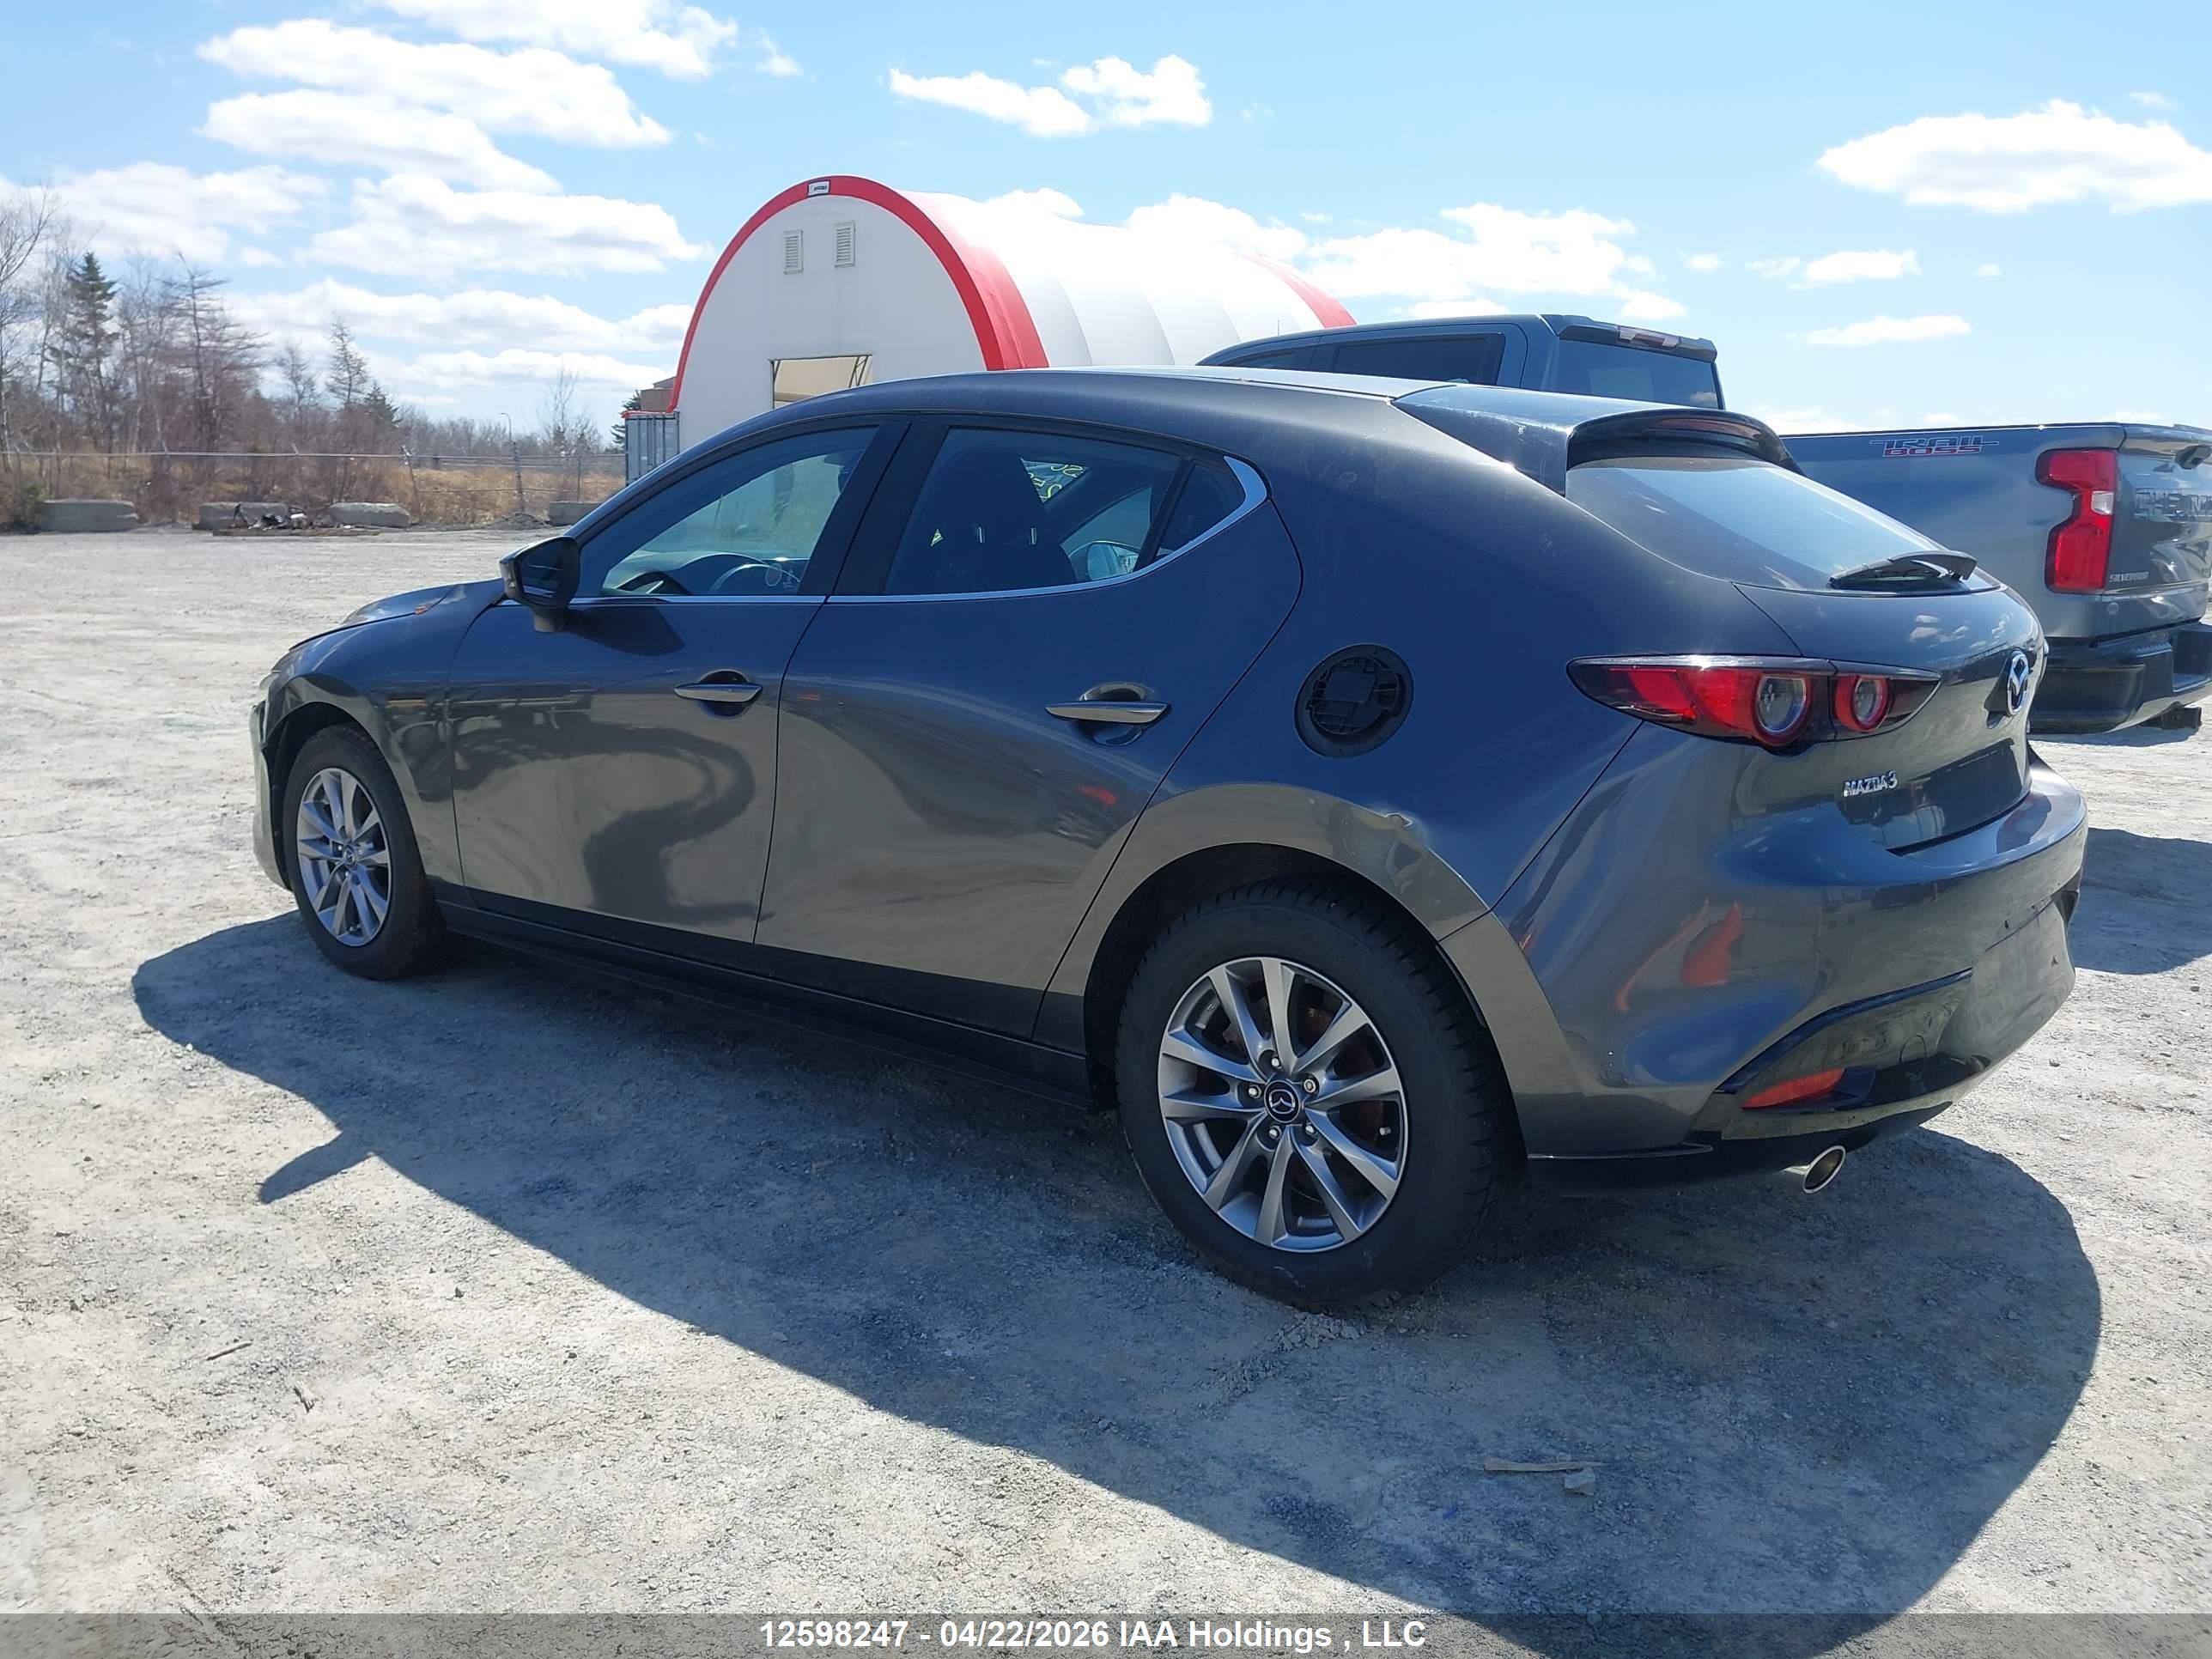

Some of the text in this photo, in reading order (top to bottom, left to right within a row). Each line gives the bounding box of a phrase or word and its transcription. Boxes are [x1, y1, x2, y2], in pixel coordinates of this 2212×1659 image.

[1869, 435, 1999, 447] TRAIL
[1883, 446, 1983, 458] BOSS
[1843, 770, 1898, 798] MAZDA3
